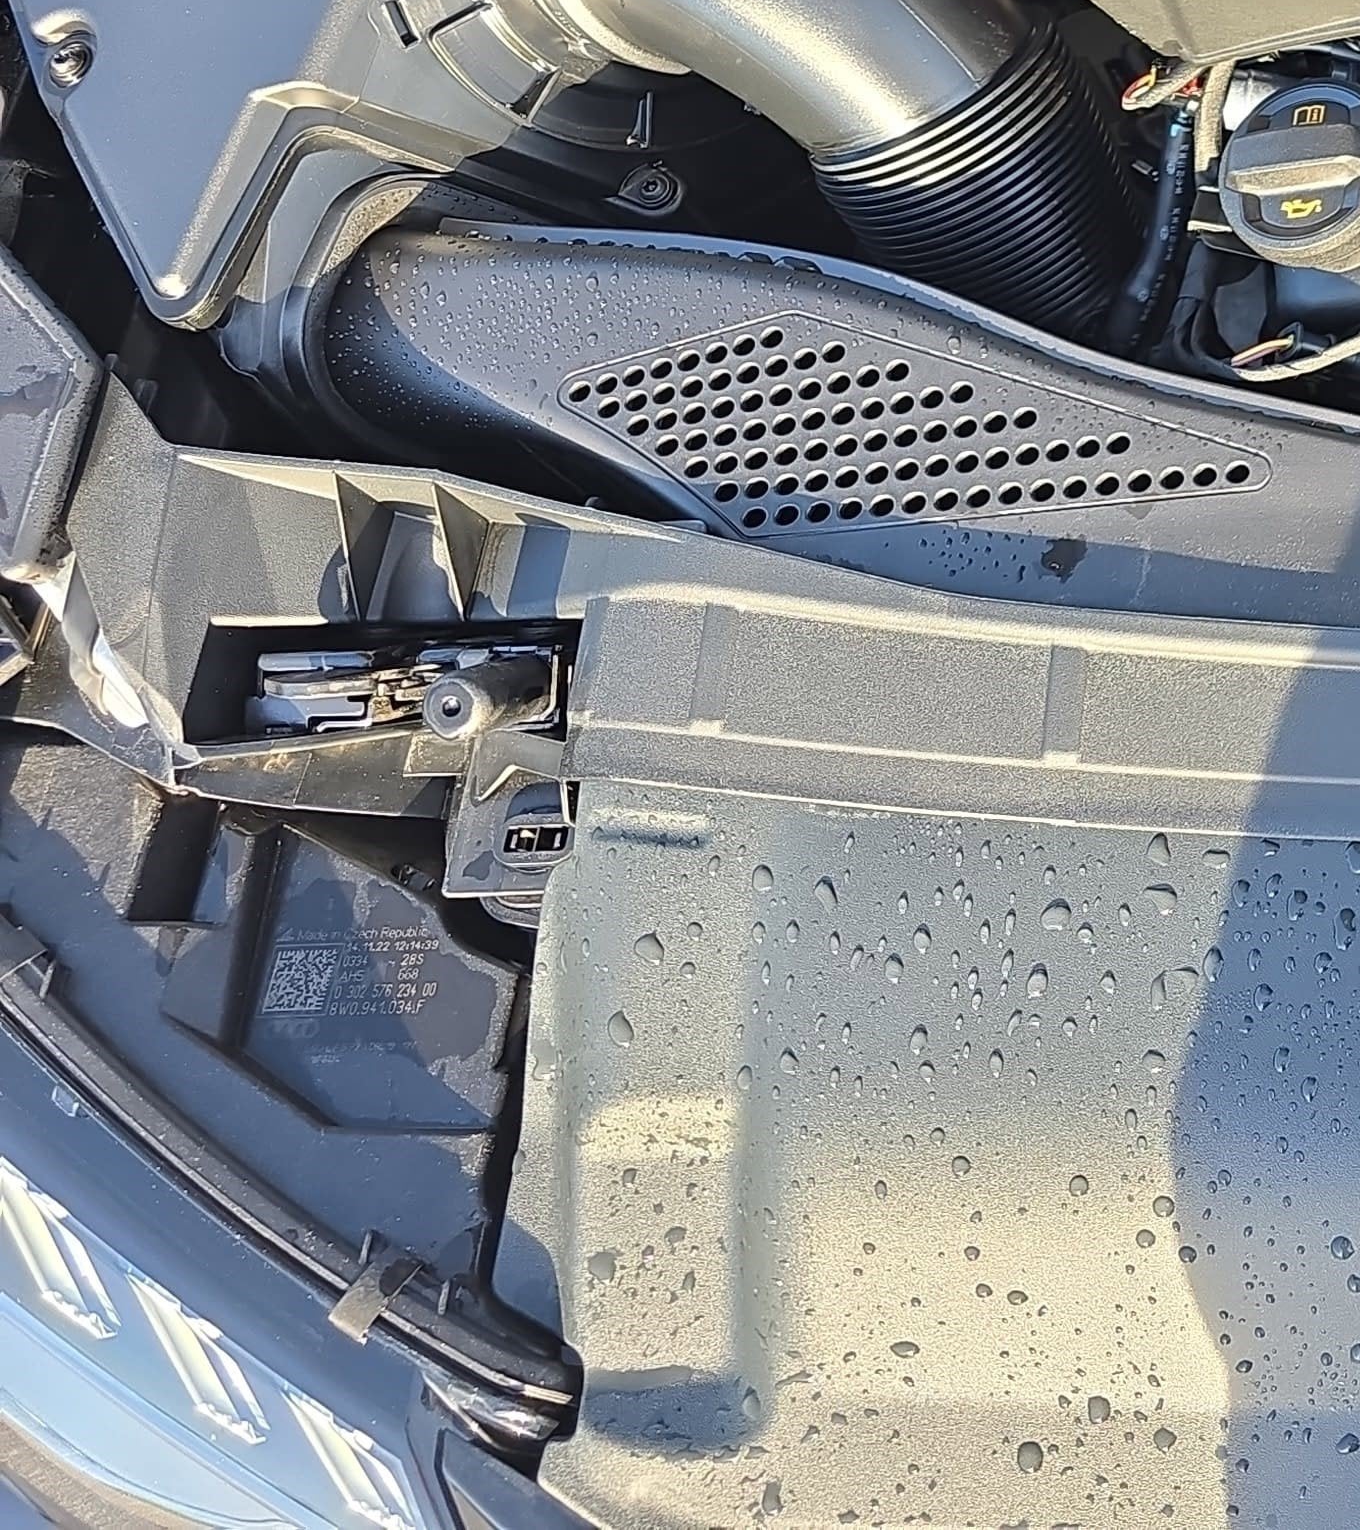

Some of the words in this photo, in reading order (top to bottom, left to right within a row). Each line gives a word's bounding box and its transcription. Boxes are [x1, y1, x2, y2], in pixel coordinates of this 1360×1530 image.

[297, 930, 328, 941] Made
[380, 926, 428, 940] Republic
[394, 940, 440, 951] 12:14:39
[372, 984, 393, 998] 576
[396, 983, 416, 998] 234
[422, 982, 437, 997] 00
